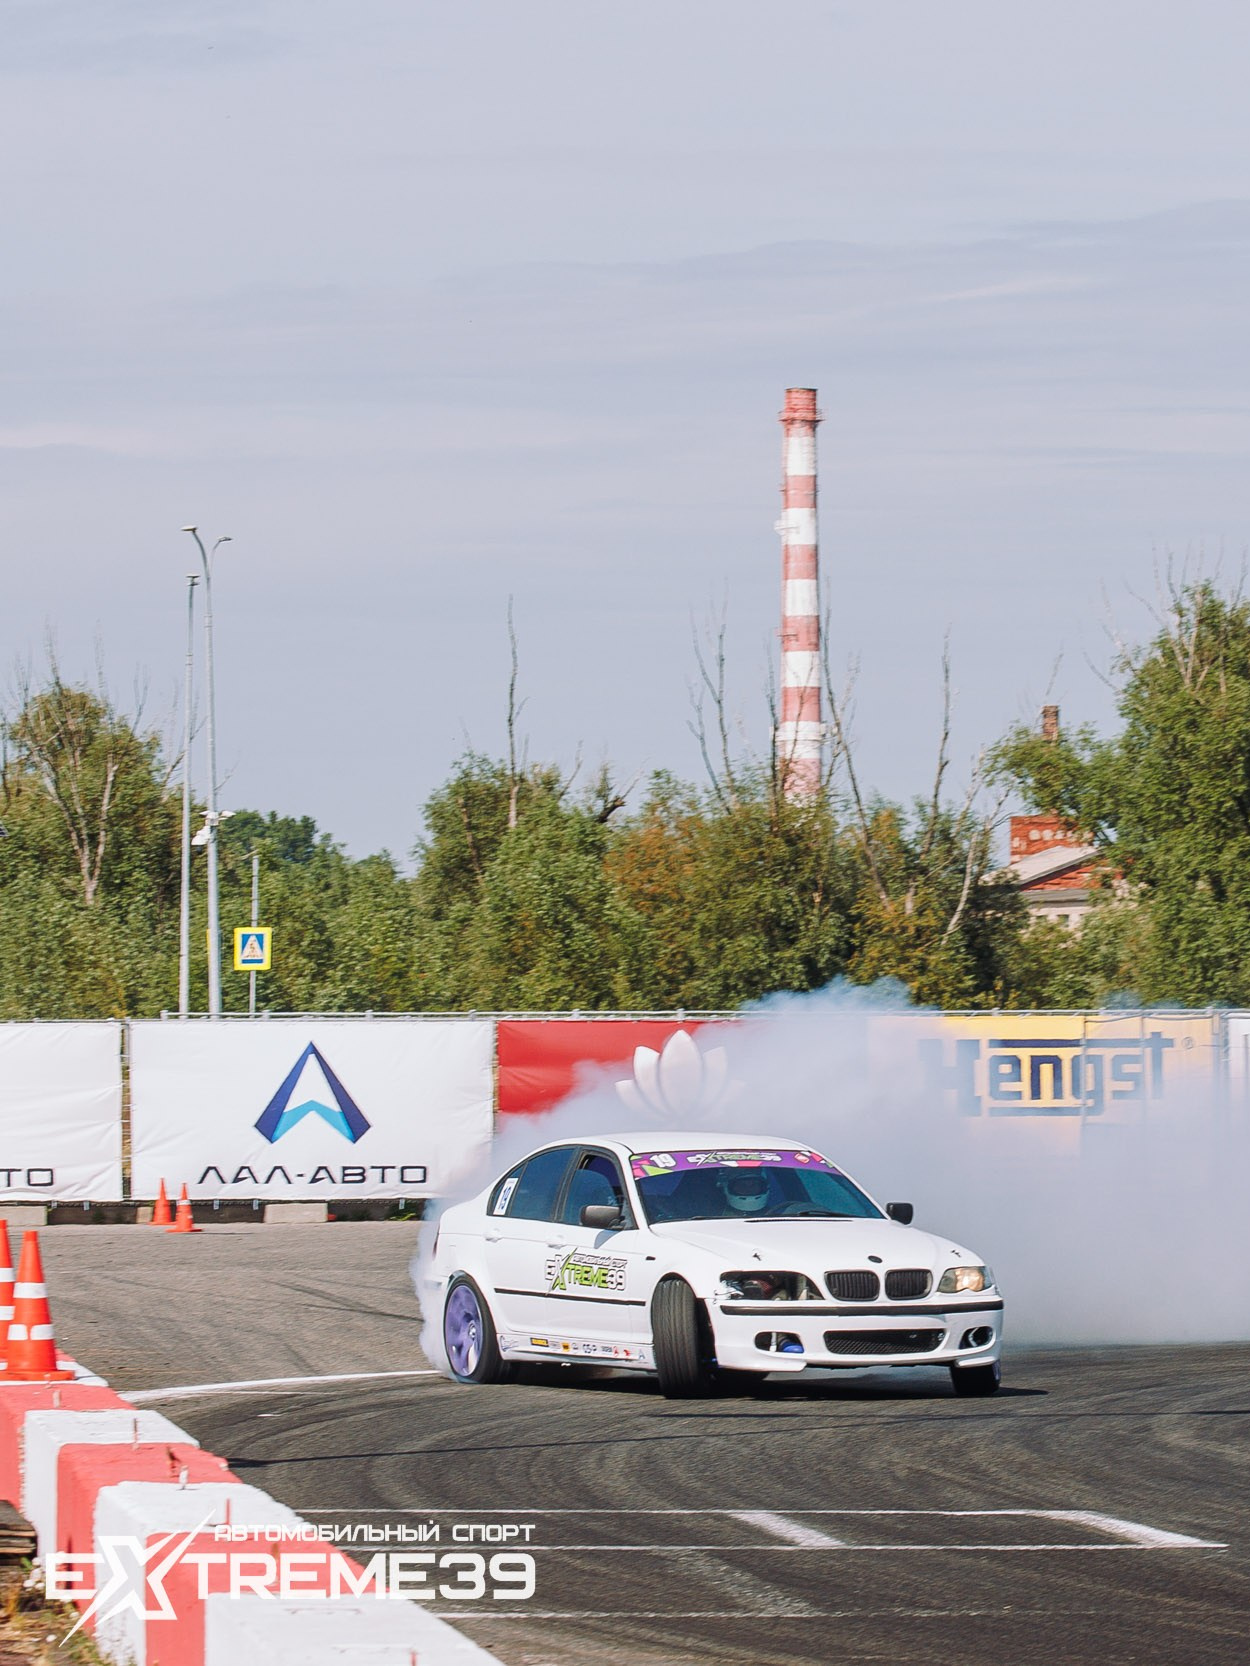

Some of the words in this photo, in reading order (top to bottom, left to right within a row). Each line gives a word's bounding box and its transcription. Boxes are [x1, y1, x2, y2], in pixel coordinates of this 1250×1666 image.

[918, 1031, 1174, 1117] Hengst
[197, 1165, 427, 1184] ЛАЛ-АВТО
[650, 1153, 677, 1168] 19
[545, 1248, 626, 1293] EXTREME39
